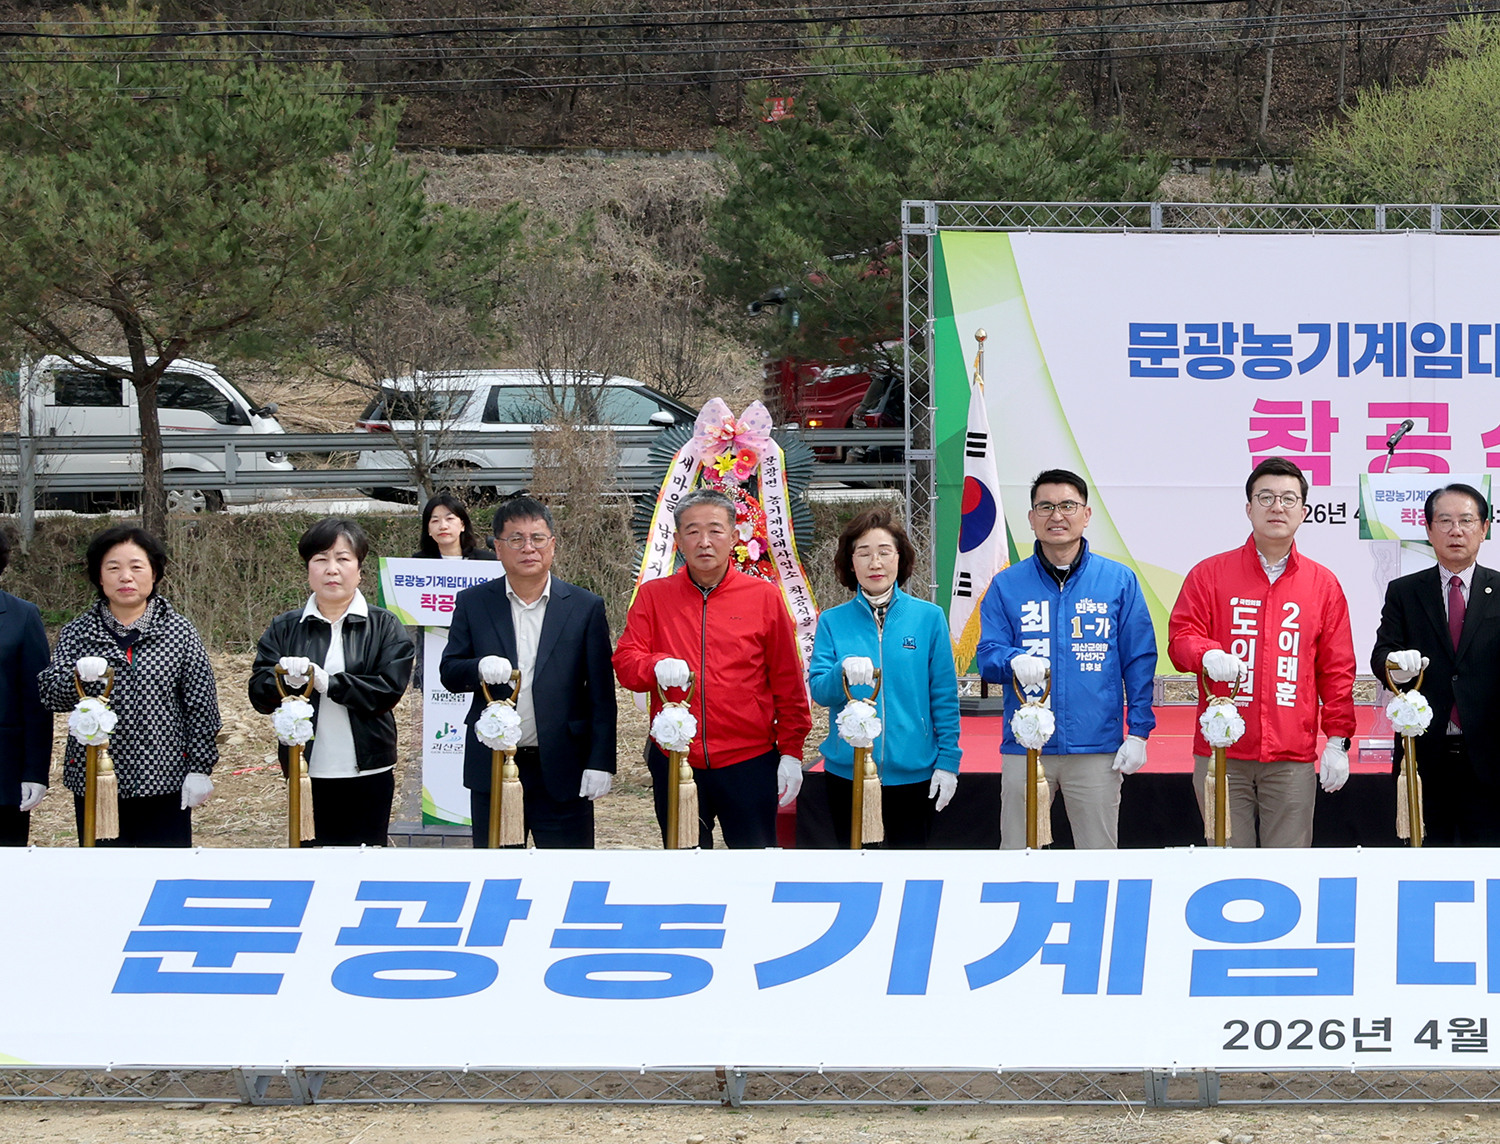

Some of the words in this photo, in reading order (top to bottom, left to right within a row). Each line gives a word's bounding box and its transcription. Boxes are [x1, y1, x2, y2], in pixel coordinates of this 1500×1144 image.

[1303, 502, 1347, 524] 26년
[420, 593, 455, 613] 착공
[1075, 602, 1108, 614] 민주당
[1071, 616, 1111, 639] 1-가
[1075, 652, 1106, 661] 가선거구
[1222, 1017, 1392, 1053] 2026년
[1414, 1017, 1488, 1053] 4월
